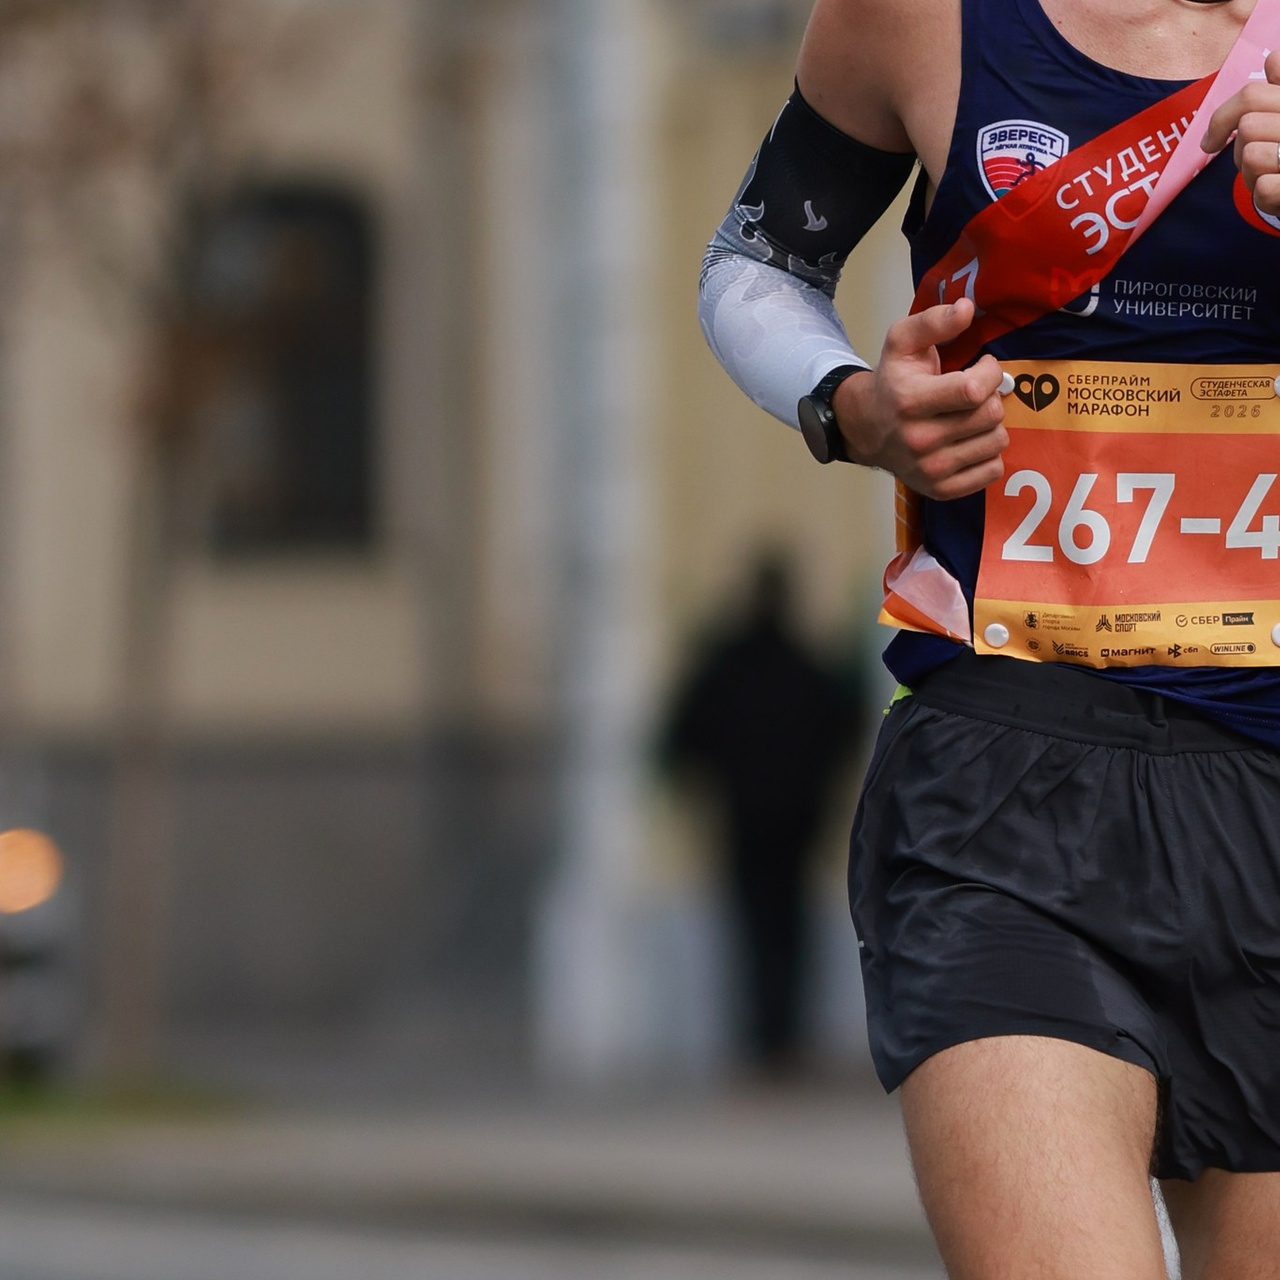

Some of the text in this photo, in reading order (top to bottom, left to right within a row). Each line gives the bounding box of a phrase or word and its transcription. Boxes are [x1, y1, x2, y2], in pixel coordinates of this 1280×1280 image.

[988, 129, 1057, 150] ЭВЕРЕСТ
[1114, 279, 1257, 303] ПИРОГОВСКИЙ
[1113, 299, 1255, 320] УНИВЕРСИТЕТ
[1067, 374, 1150, 386] СБЕРПРАЙМ
[1200, 380, 1271, 389] СТУДЕНЧЕСКАЯ
[1067, 387, 1181, 402] МОСКОВСКИЙ
[1199, 389, 1248, 397] ЭСТАФЕТА
[1067, 402, 1150, 417] МАРАФОН
[1210, 404, 1261, 418] 2026
[1114, 610, 1161, 623] МОСКОВСКИЙ
[1191, 615, 1220, 625] СБЕР
[1114, 623, 1137, 632] СПОРТ
[1183, 646, 1199, 654] сбп
